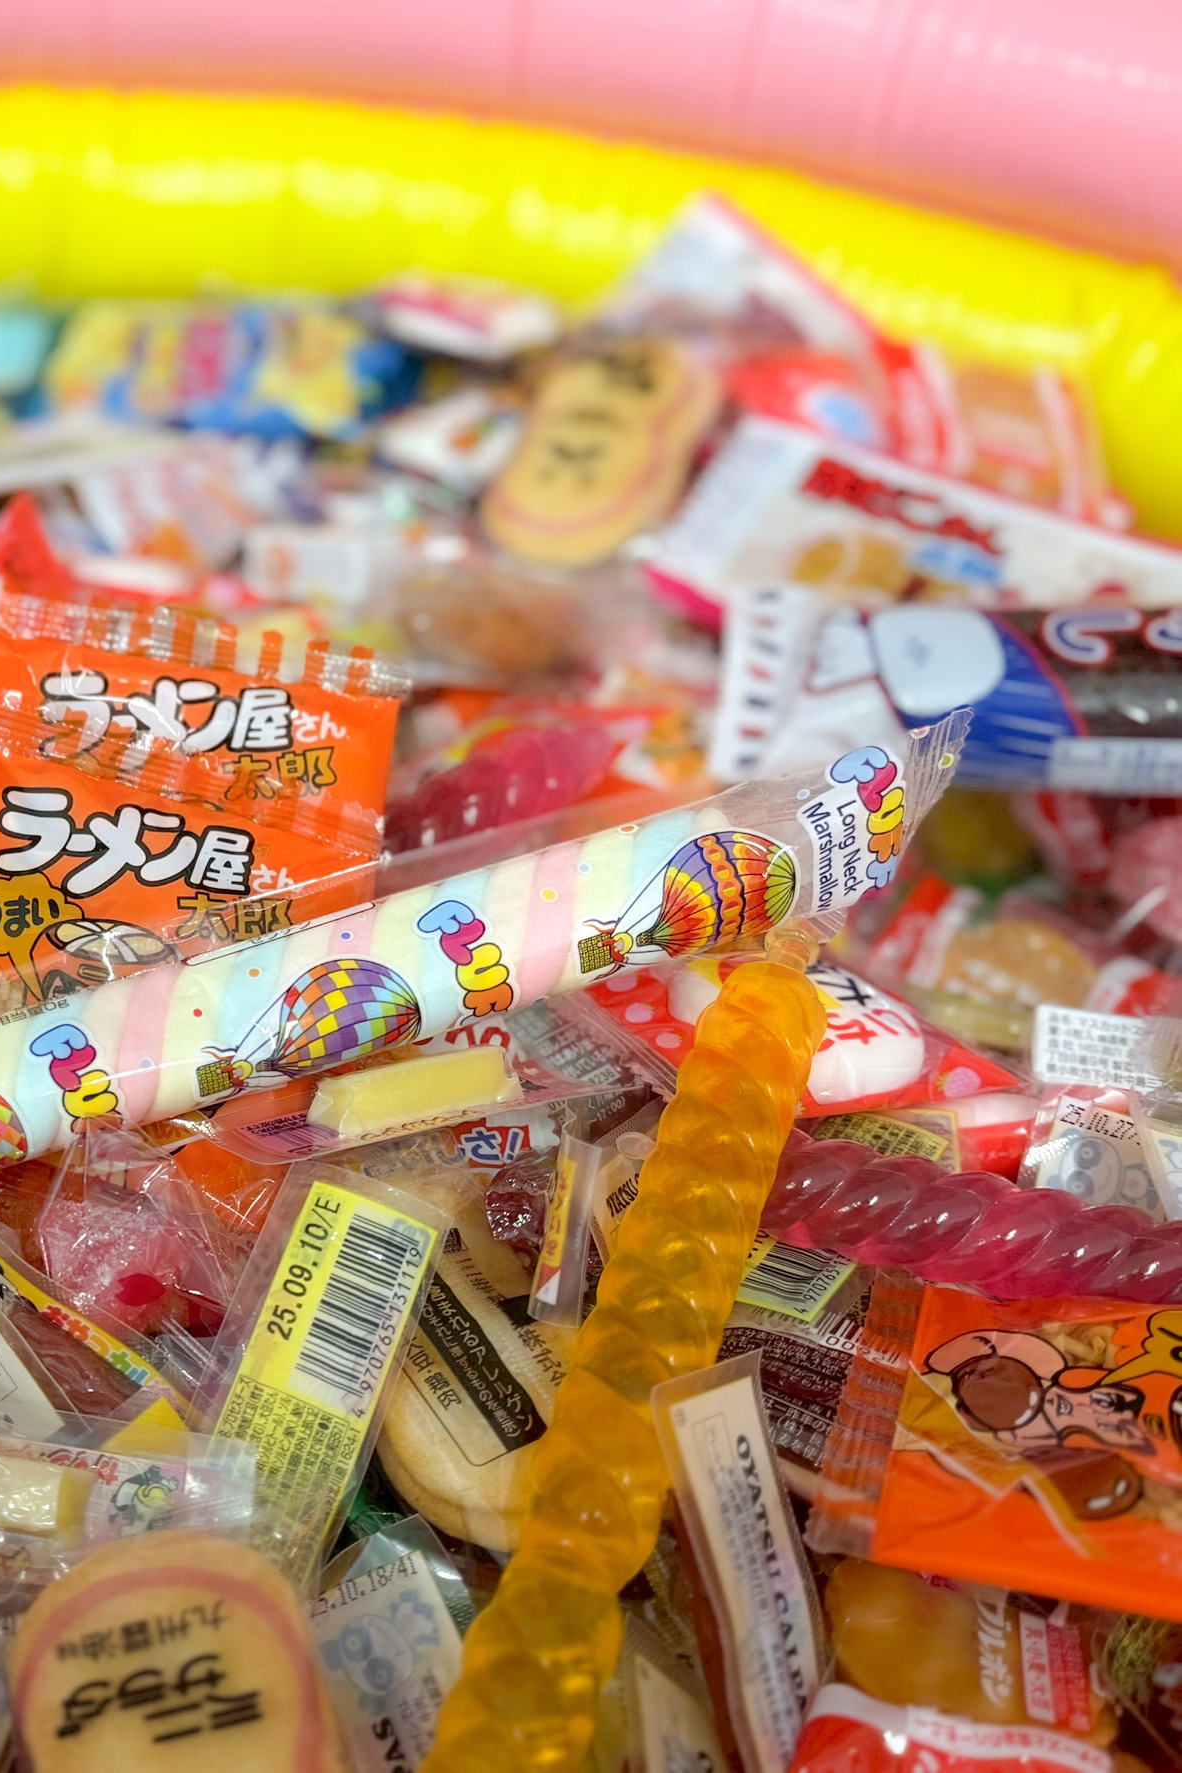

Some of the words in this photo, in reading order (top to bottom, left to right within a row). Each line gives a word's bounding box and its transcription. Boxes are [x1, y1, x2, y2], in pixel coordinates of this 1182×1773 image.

[224, 746, 338, 798] 太郎
[836, 798, 858, 851] Long
[801, 800, 840, 913] Marshmallow
[842, 847, 864, 897] Neck
[176, 894, 293, 944] 太郎
[265, 1192, 342, 1341] 25.09.10/E
[144, 1690, 264, 1744] ミニ
